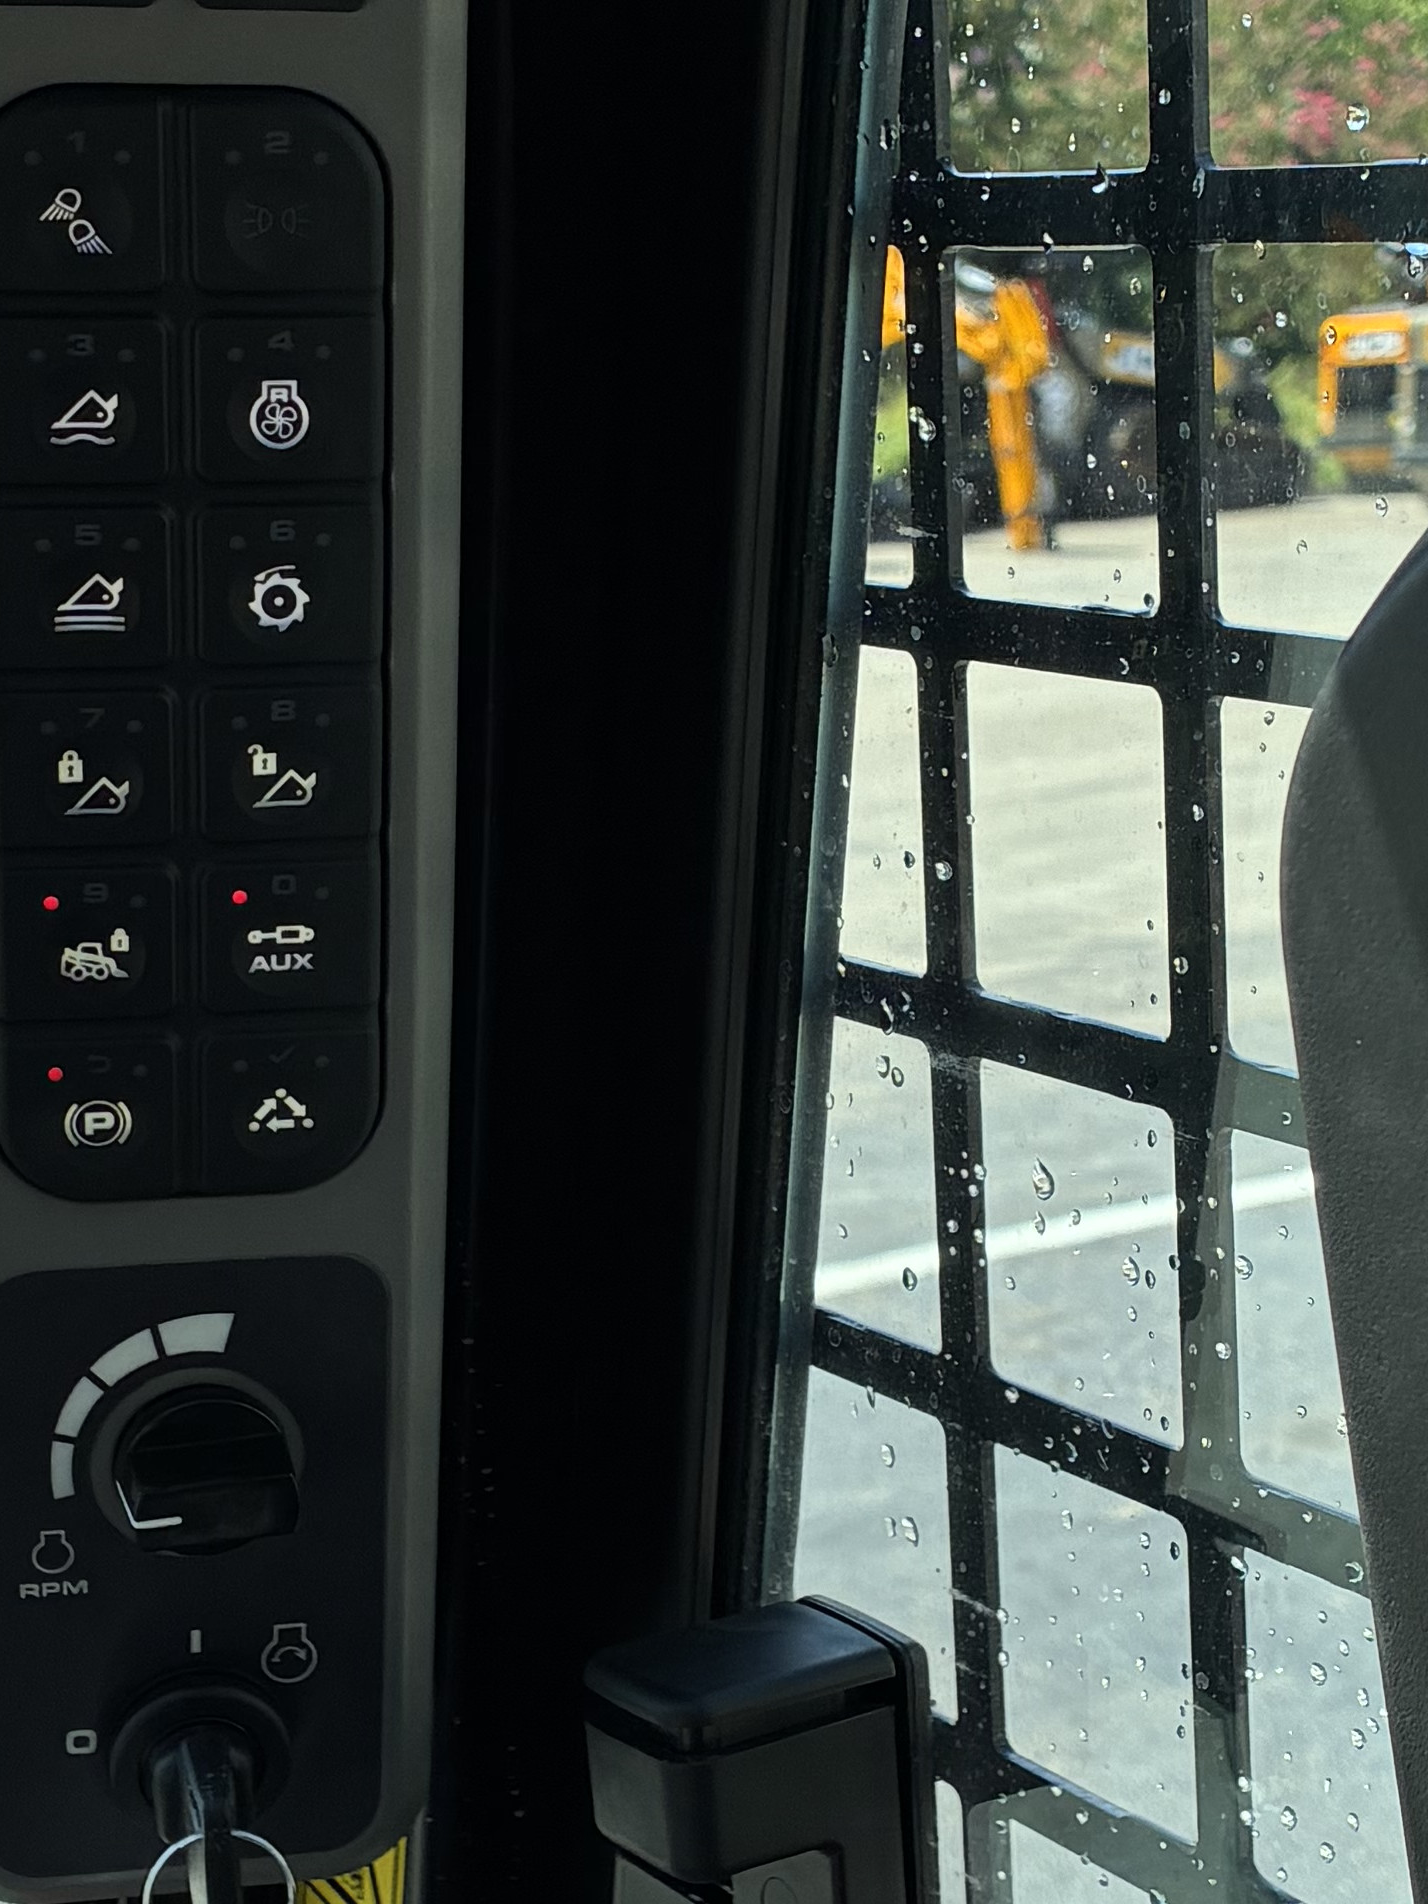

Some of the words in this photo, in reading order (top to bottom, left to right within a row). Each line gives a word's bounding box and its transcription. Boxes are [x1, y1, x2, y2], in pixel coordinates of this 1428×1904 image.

[263, 130, 292, 155] 2
[67, 333, 95, 357] 3
[268, 329, 295, 352] 4
[74, 523, 103, 547] 5
[269, 519, 297, 542] 6
[78, 707, 106, 729] 7
[271, 699, 297, 722] 8
[83, 881, 110, 904] 9
[248, 952, 315, 974] AUX
[84, 1111, 115, 1136] P
[19, 1580, 89, 1600] RPM
